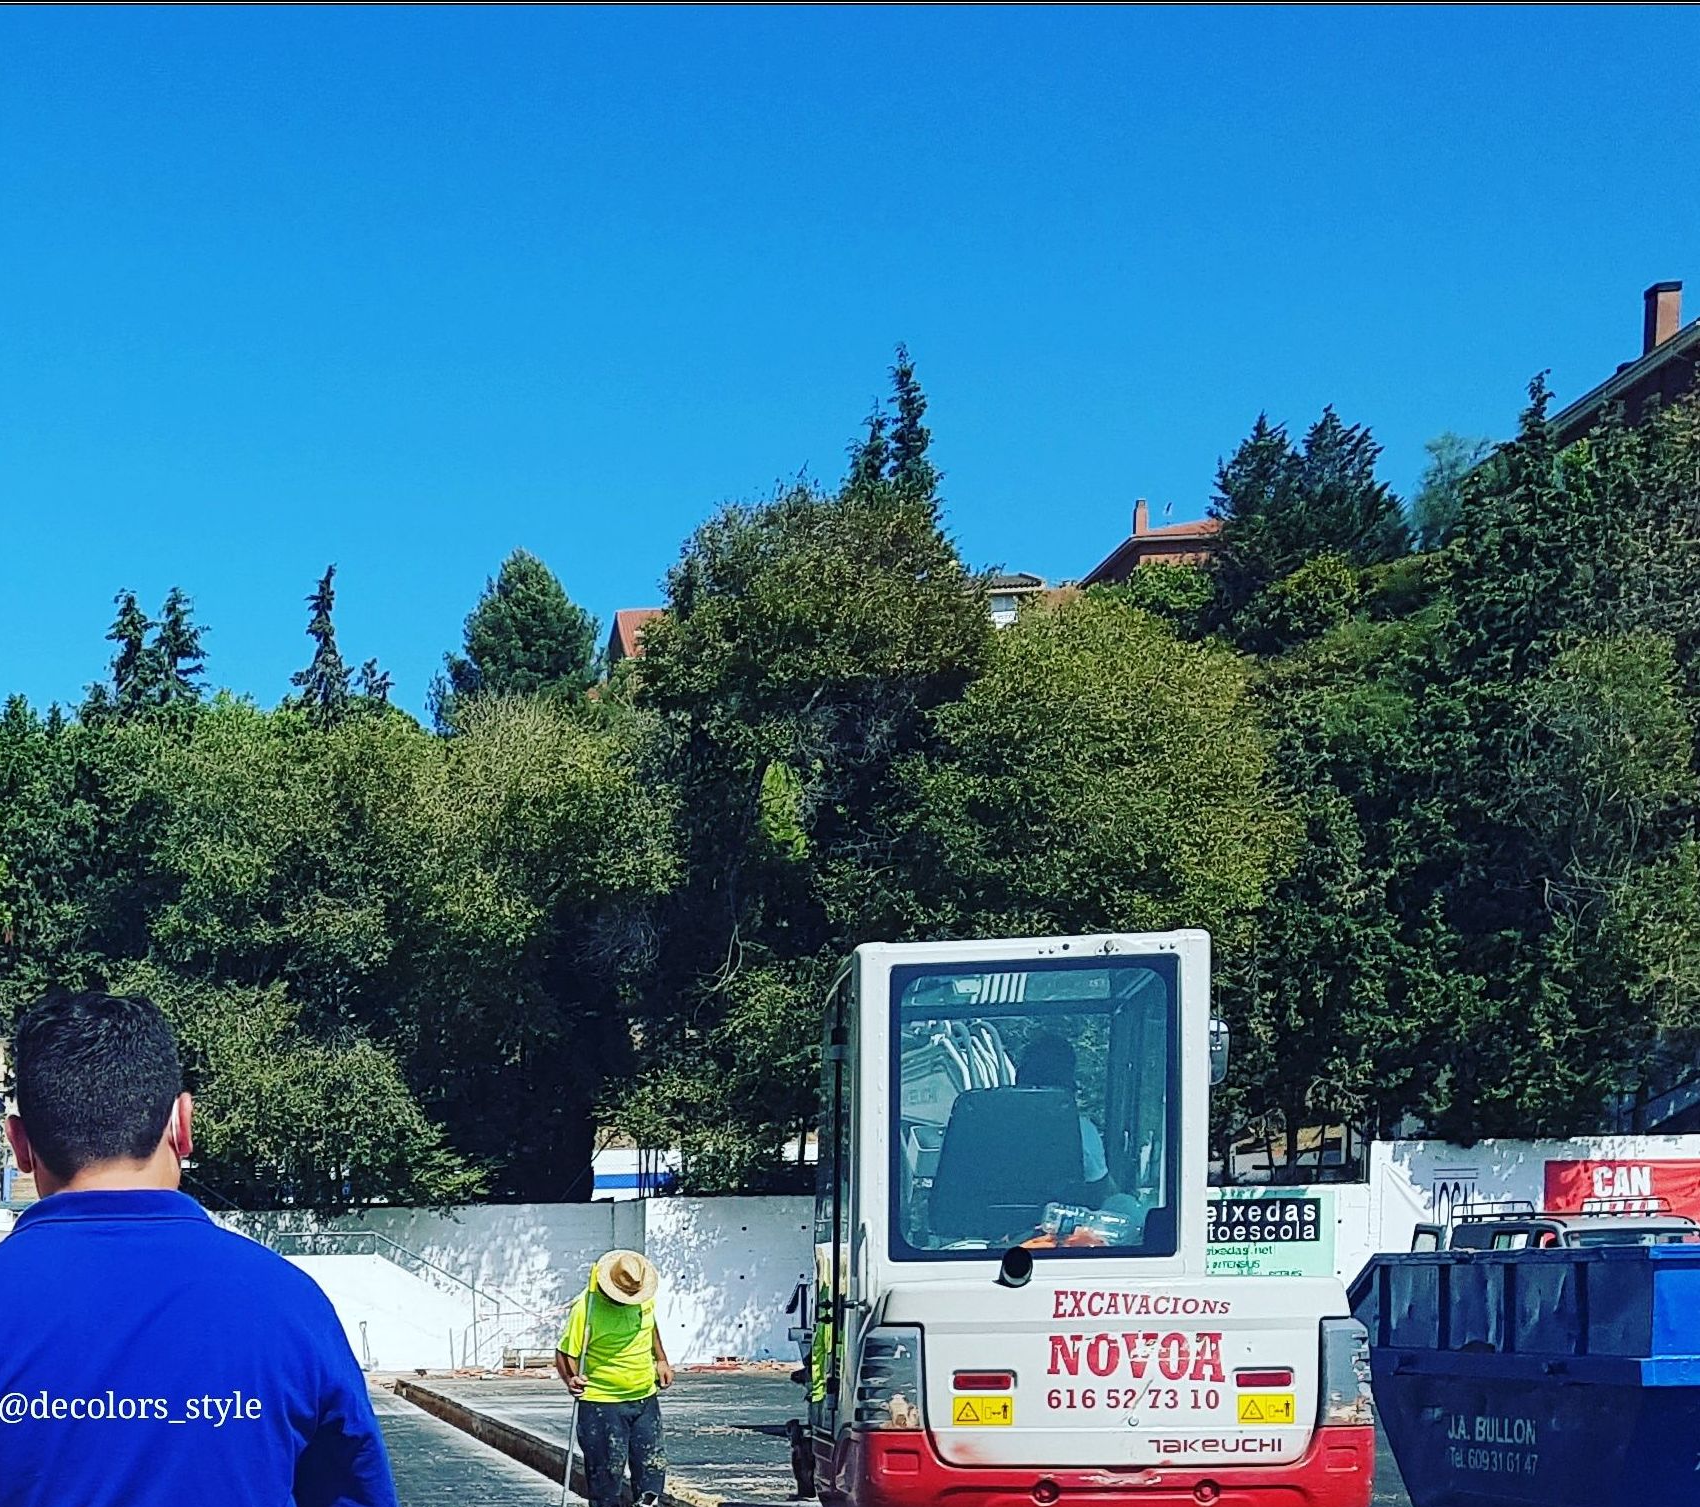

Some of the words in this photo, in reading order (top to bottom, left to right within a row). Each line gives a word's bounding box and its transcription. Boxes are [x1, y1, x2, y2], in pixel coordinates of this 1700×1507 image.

[1592, 1165, 1651, 1197] CAN
[1207, 1200, 1316, 1222] eixedas
[1207, 1220, 1316, 1241] toescola
[1053, 1290, 1231, 1318] EXCAVACIONS
[1047, 1332, 1225, 1382] NOVOA
[1047, 1389, 1096, 1409] 616
[1106, 1389, 1137, 1409] 52
[1148, 1389, 1179, 1409] 73
[1191, 1389, 1219, 1409] 10
[1448, 1415, 1471, 1441] J.A.
[1475, 1416, 1537, 1445] BULLON
